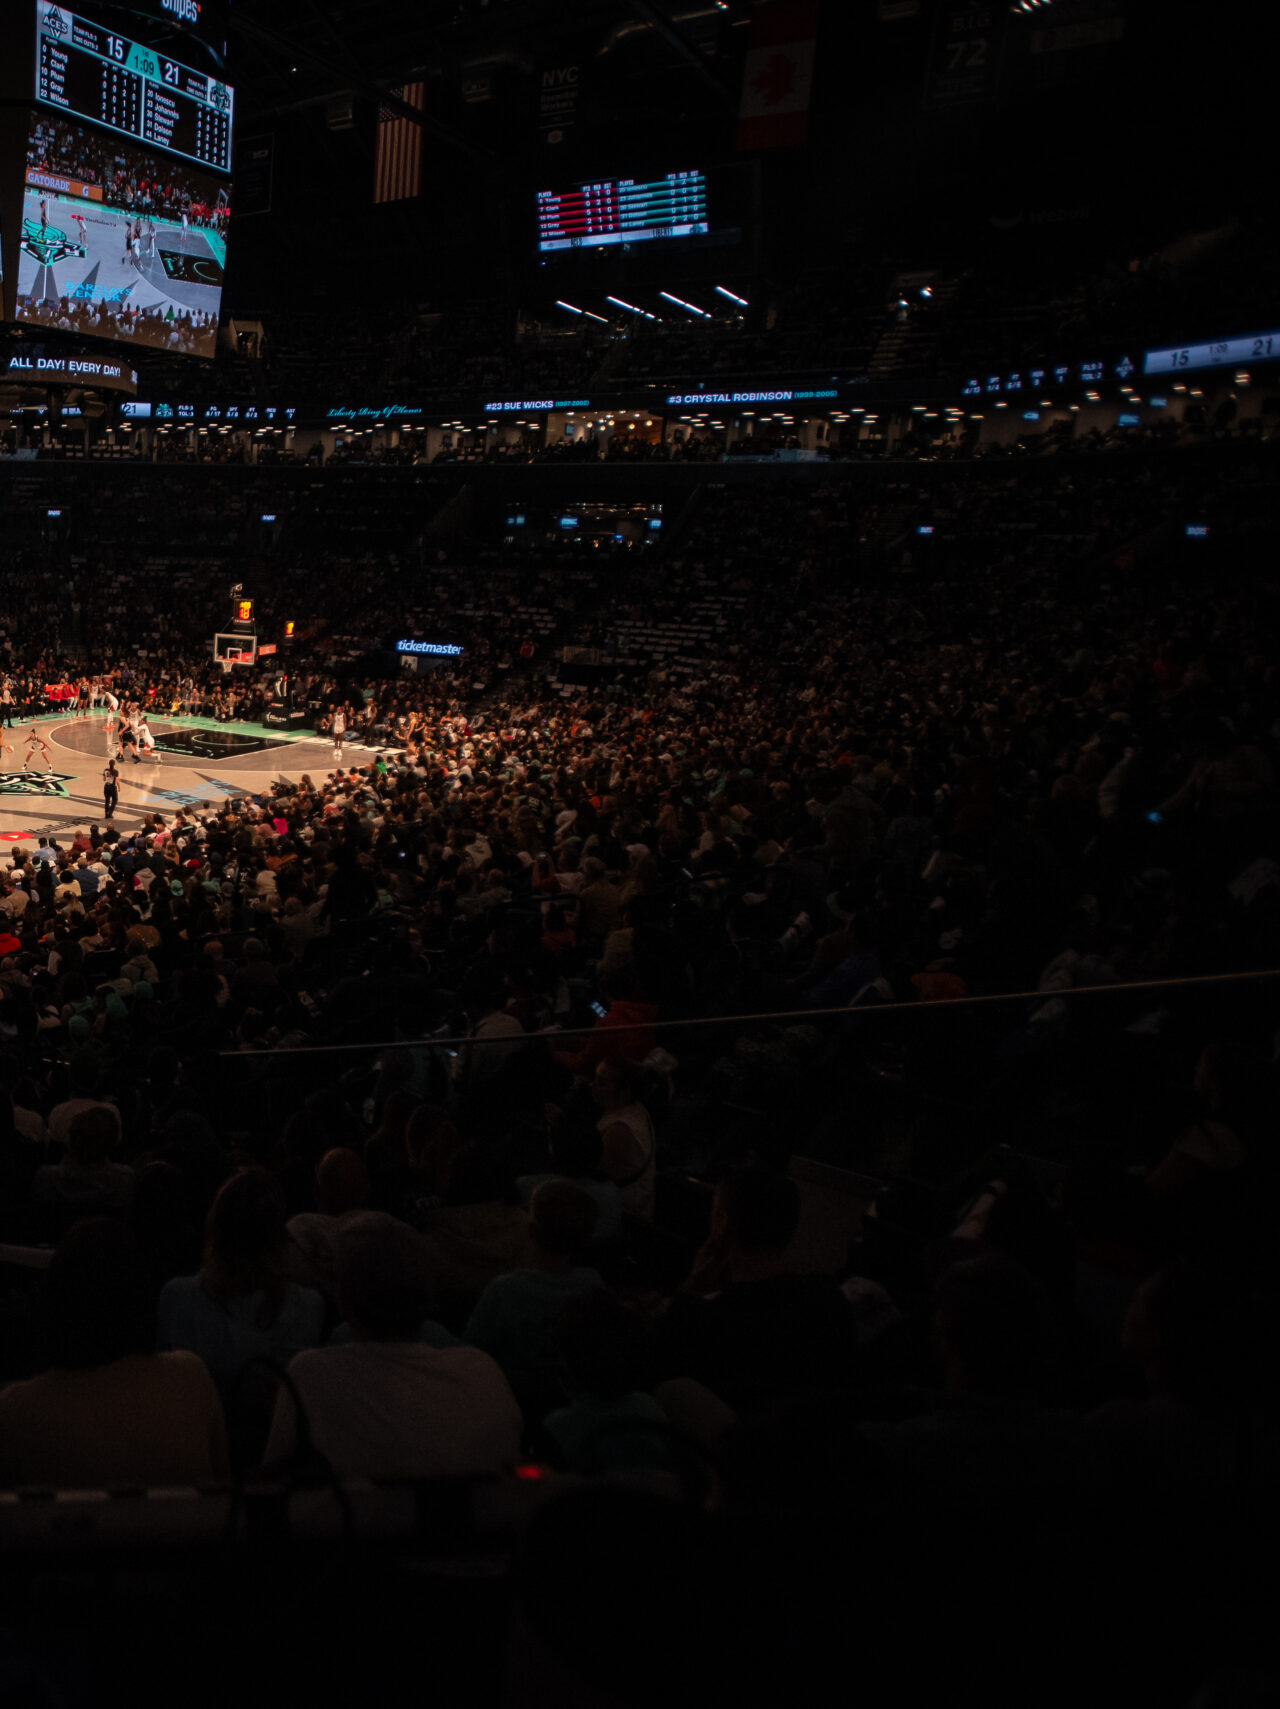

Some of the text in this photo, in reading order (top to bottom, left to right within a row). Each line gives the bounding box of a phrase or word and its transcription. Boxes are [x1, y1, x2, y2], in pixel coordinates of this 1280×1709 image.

[42, 15, 68, 34] ACES
[50, 47, 68, 63] Young
[107, 36, 124, 60] 15
[947, 38, 987, 69] 72
[50, 59, 66, 72] Clark
[134, 54, 154, 75] 1:09
[50, 70, 64, 82] Plum
[164, 61, 180, 86] 21
[541, 66, 580, 87] NYC
[50, 81, 64, 94] Gray
[50, 92, 69, 106] Wilson
[28, 171, 88, 197] GATORADE G
[1252, 339, 1272, 356] 21
[1172, 351, 1189, 366] 15
[10, 357, 120, 377] ALL DAY! EVERY DAY!
[486, 402, 502, 410] #23
[504, 402, 522, 410] SUE
[523, 400, 554, 409] WICKS
[669, 394, 682, 404] #3
[684, 394, 731, 403] CRYSTAL
[734, 391, 793, 402] ROBINSON
[126, 405, 136, 414] 21
[326, 405, 357, 420] Liberty
[358, 406, 380, 419] Ring
[398, 640, 462, 655] ticketmaster
